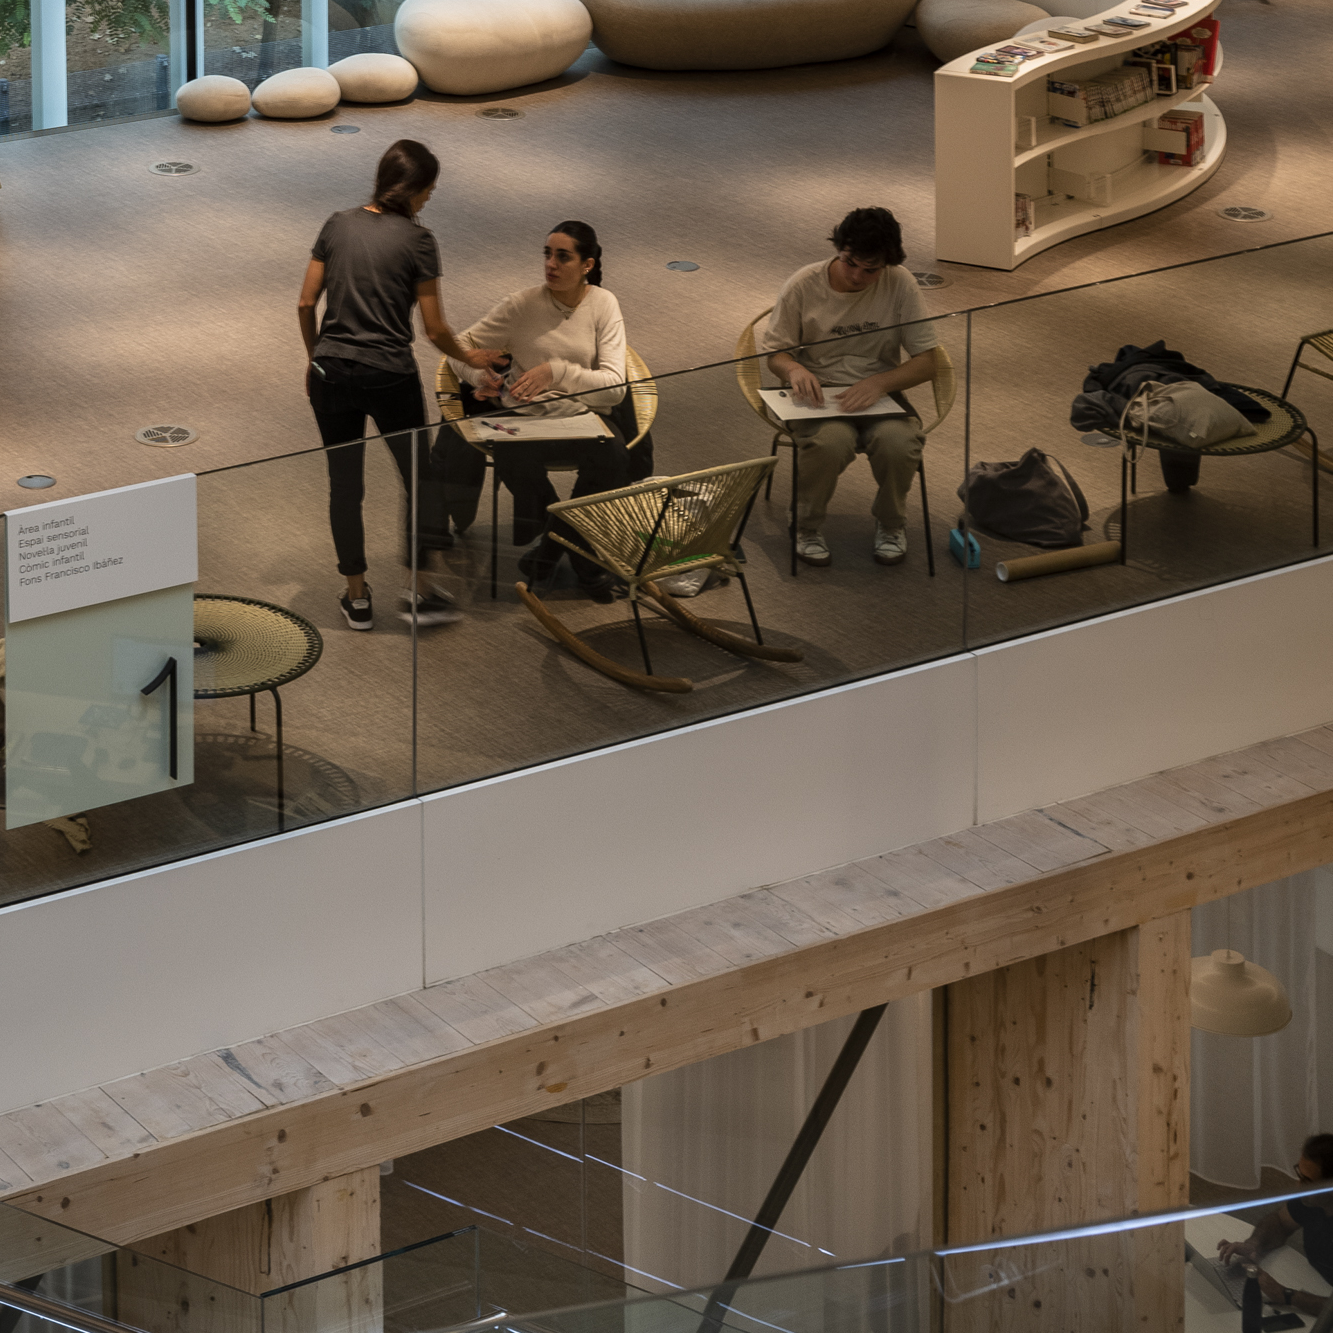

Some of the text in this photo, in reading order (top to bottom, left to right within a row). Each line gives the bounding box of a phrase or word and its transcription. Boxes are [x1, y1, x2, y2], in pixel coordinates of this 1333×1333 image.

[18, 516, 75, 536] Àrea infantil
[19, 526, 89, 549] Espai sensorial
[57, 539, 89, 556] juvenil
[20, 552, 85, 575] Còmic infantil
[20, 556, 124, 587] Fons Francisco Ibáñez
[140, 656, 178, 781] 1
